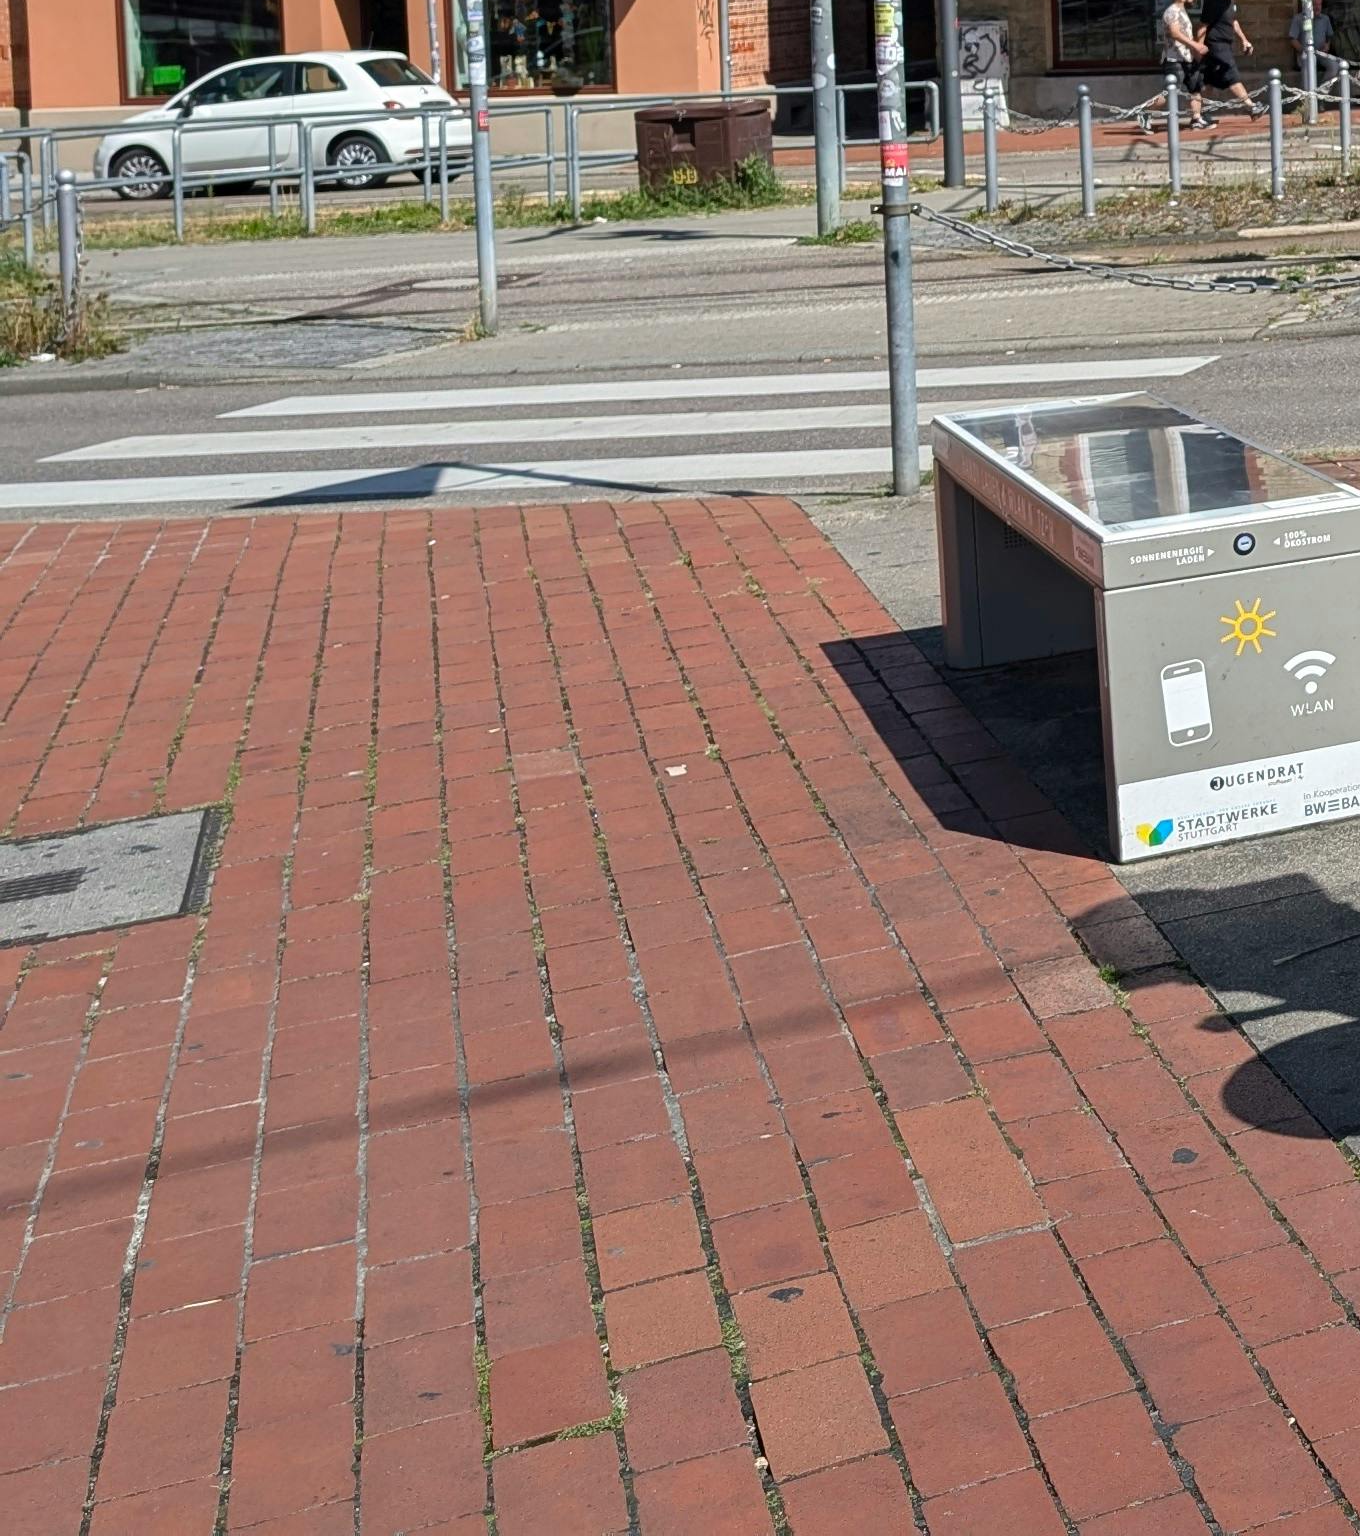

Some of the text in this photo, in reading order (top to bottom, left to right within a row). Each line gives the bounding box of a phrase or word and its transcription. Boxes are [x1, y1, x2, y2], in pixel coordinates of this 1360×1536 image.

[1284, 530, 1307, 540] 100%
[1284, 534, 1331, 548] ÖKOSTROM
[1130, 546, 1204, 565] SONNENENERGIE
[1176, 554, 1205, 566] LADEN
[1290, 698, 1334, 716] WLAN
[1210, 763, 1304, 791] JUGENDRAT
[1303, 792, 1311, 800] in
[1177, 803, 1279, 832] STADTWERKE
[1178, 823, 1239, 842] STUTTGART
